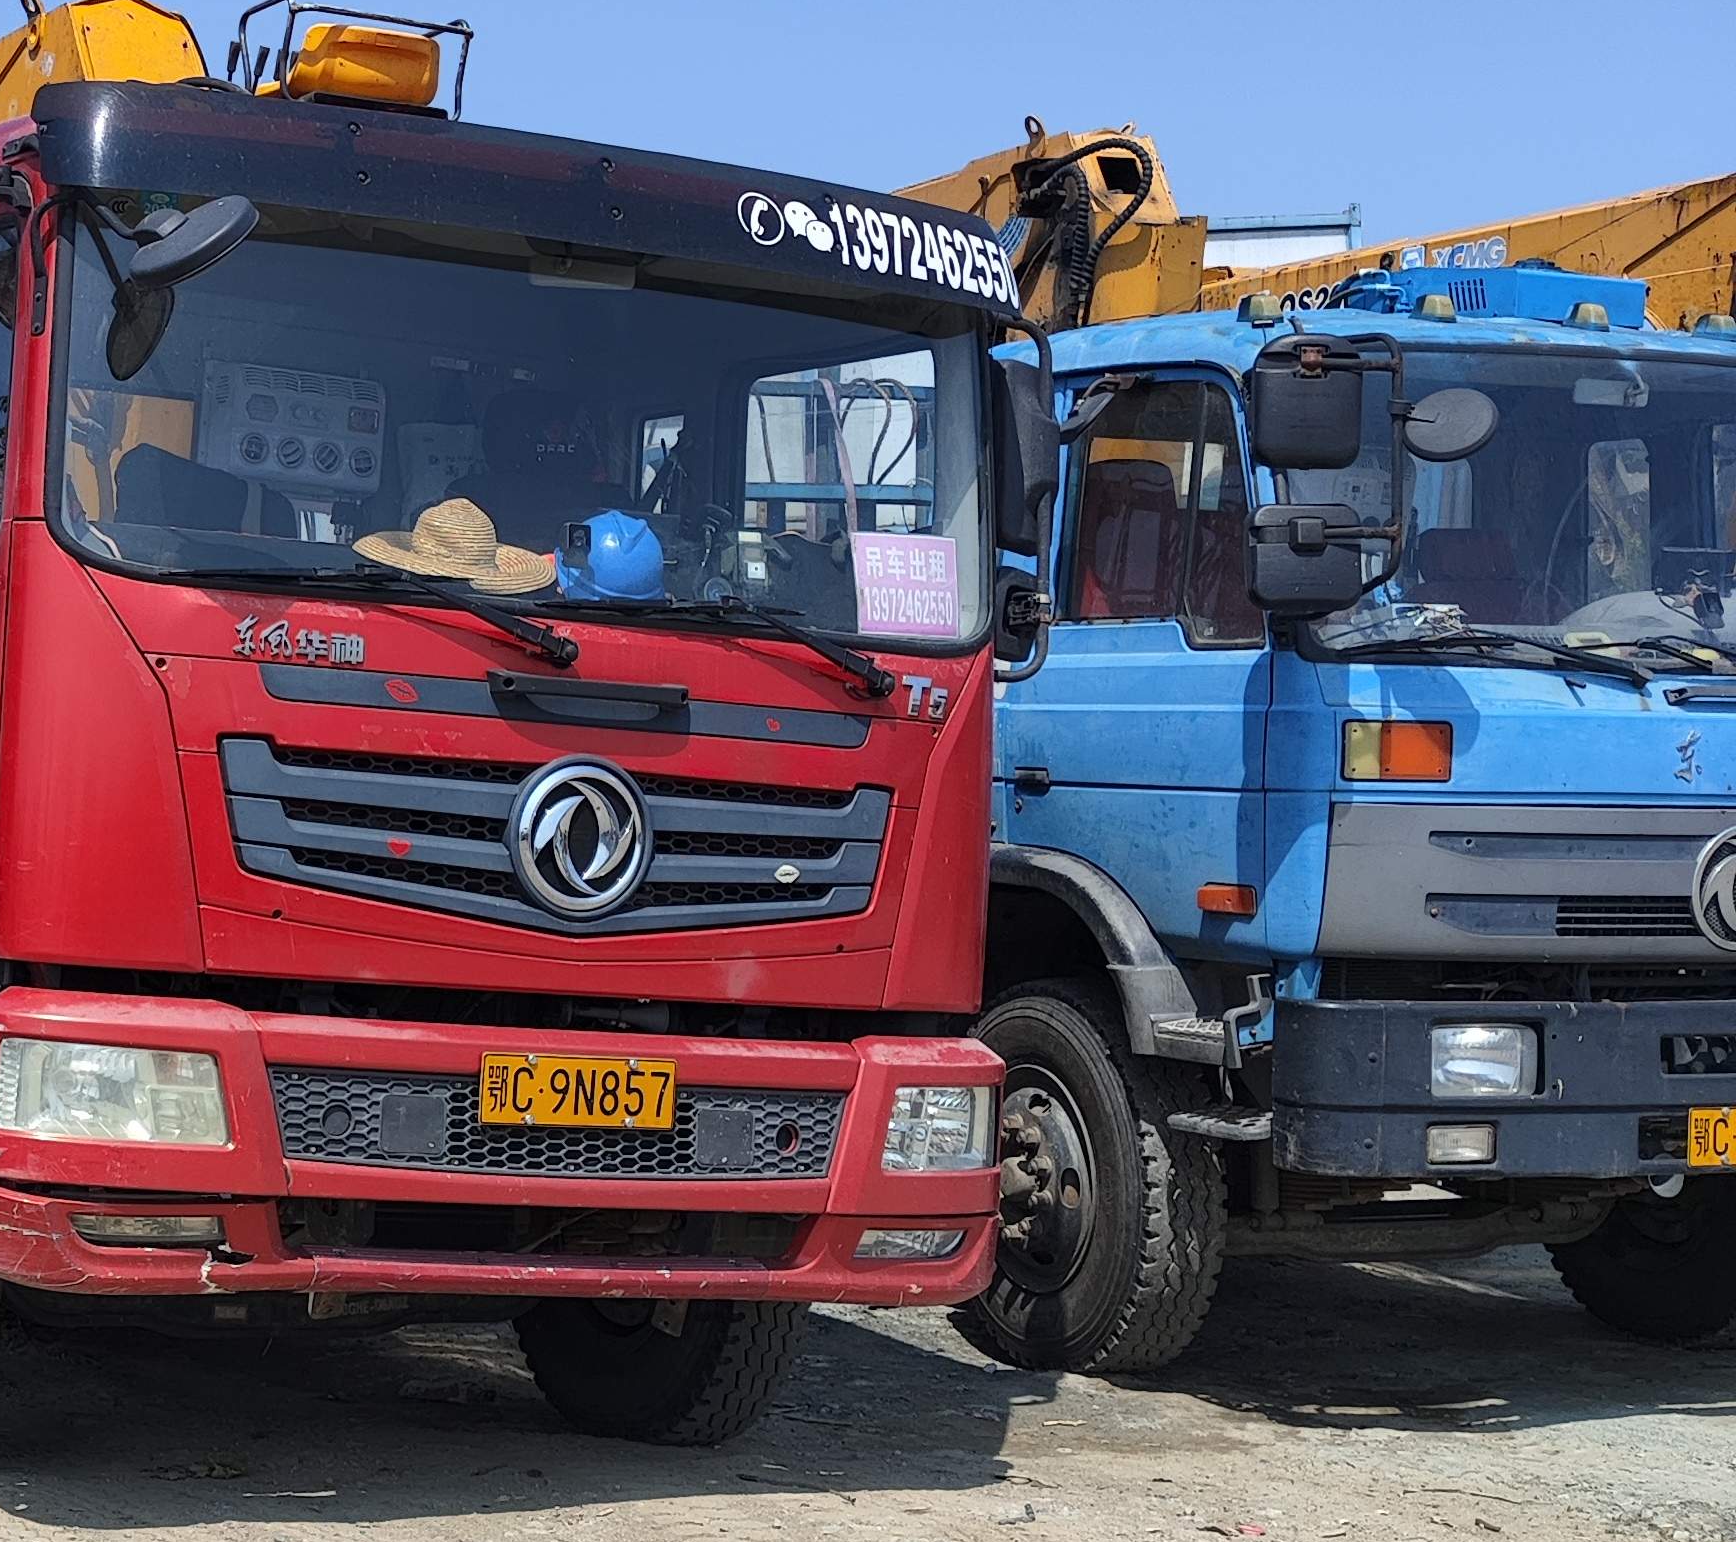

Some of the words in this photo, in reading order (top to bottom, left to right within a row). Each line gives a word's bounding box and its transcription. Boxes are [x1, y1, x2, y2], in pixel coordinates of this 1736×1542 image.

[829, 202, 1022, 310] 13972462550
[1431, 236, 1506, 268] XCMG
[865, 546, 948, 584] 吊车出租
[864, 586, 953, 626] 13972462550
[902, 674, 949, 719] T5
